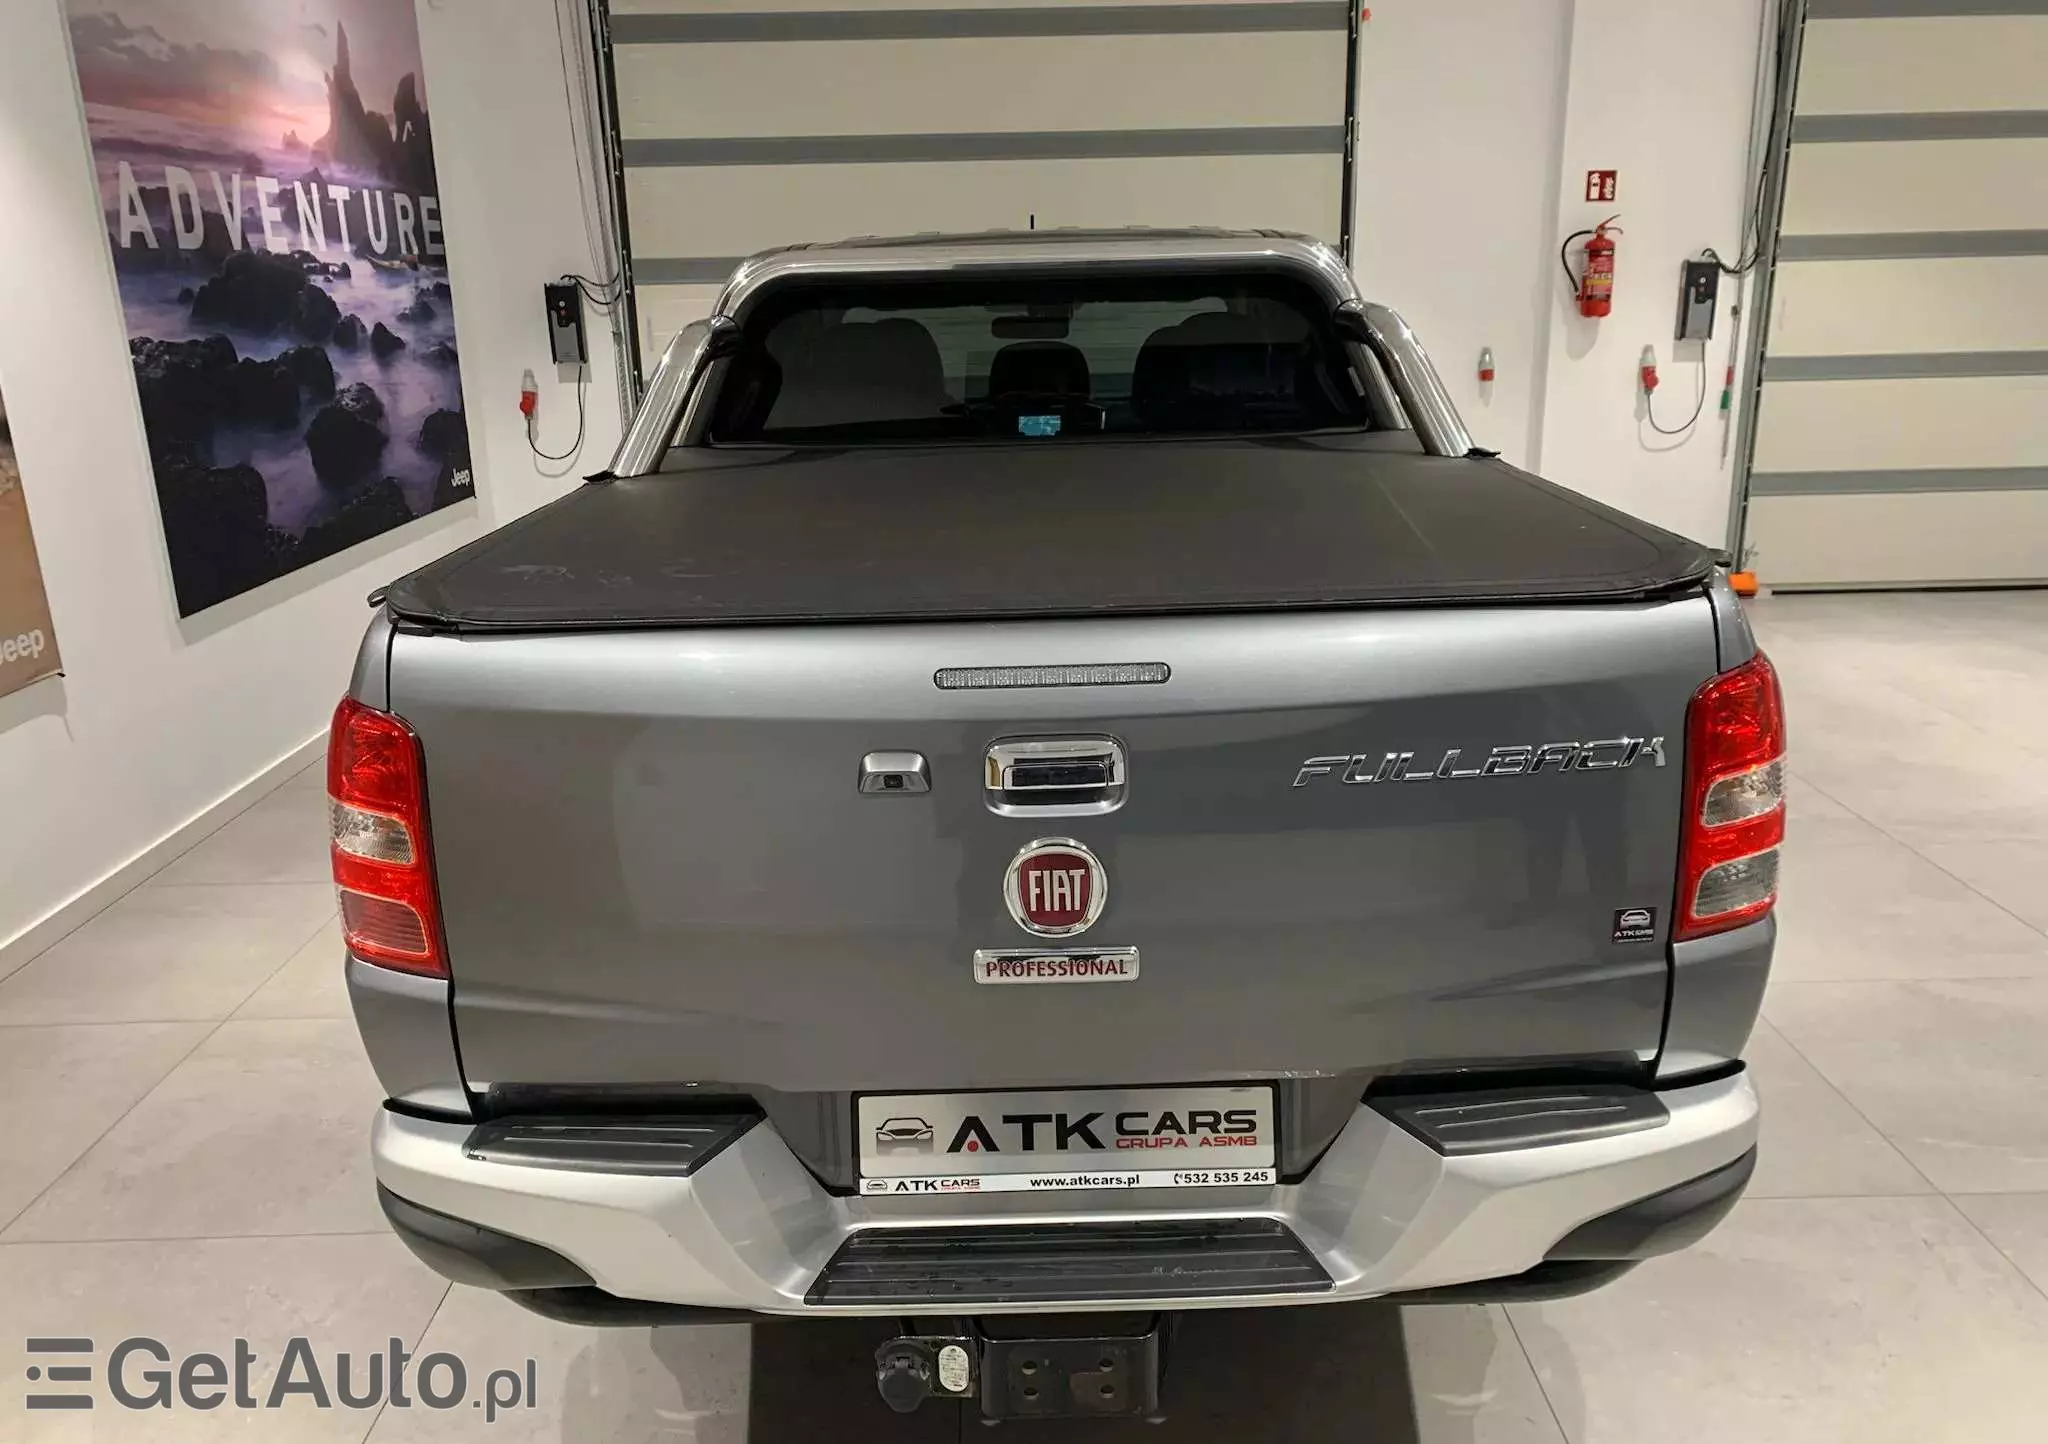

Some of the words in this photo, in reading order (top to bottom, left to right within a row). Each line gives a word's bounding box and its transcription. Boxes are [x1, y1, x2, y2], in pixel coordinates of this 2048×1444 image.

[119, 161, 445, 257] ADVENTURE
[451, 468, 470, 487] Jeep
[1292, 736, 1665, 787] FULLBACK
[1028, 869, 1086, 912] FIAT
[986, 959, 1128, 977] PROFESSIONAL
[946, 1112, 1106, 1153] ATK
[1115, 1110, 1257, 1135] CARS
[1115, 1136, 1185, 1149] GRUPA
[1199, 1136, 1257, 1147] ASMB
[895, 1180, 938, 1191] ATK
[941, 1178, 980, 1187] CARS
[1030, 1174, 1140, 1187] www.atkcars.pl
[1184, 1173, 1209, 1184] 532
[1213, 1172, 1239, 1183] 535
[1243, 1171, 1269, 1183] 245
